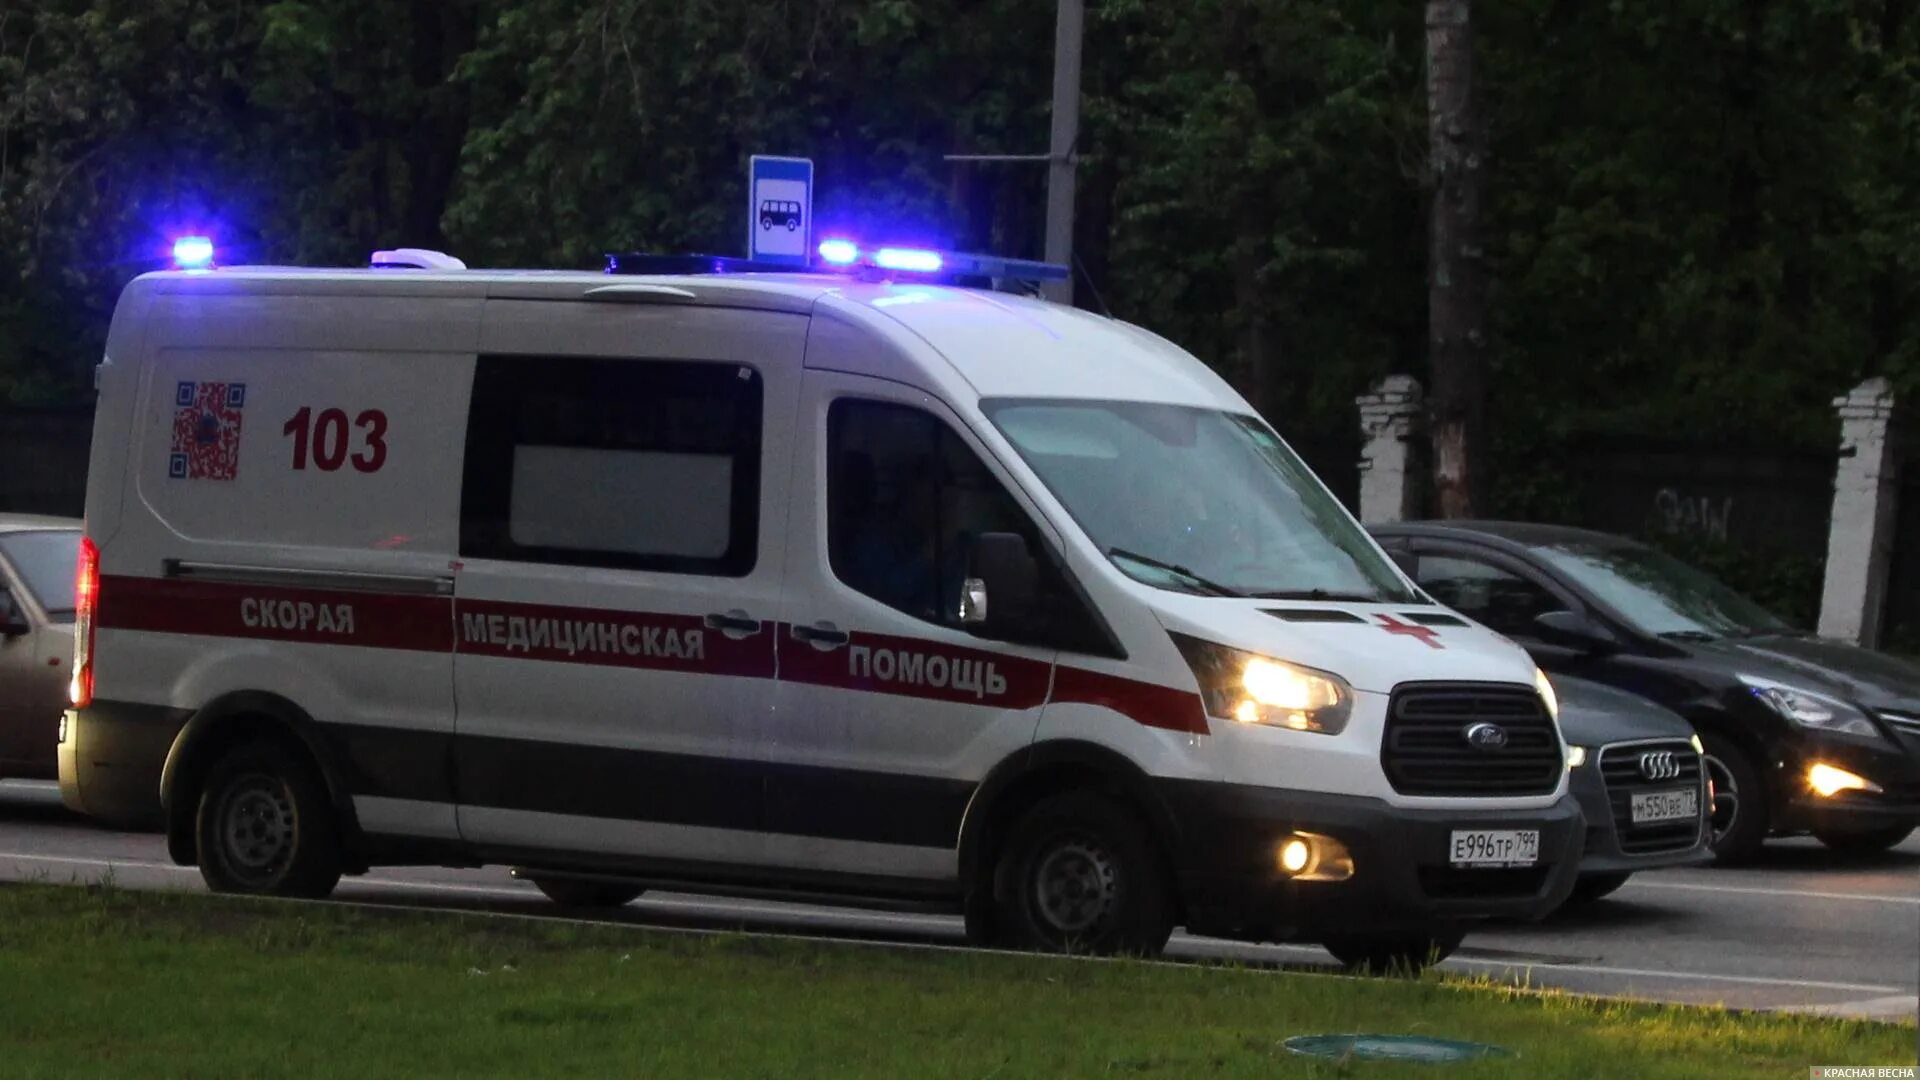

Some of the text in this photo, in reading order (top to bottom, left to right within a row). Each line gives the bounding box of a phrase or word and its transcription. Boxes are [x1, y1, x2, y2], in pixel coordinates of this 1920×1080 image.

[284, 407, 388, 473] 103
[241, 598, 1007, 698] СКОРАЯ МЕДИЦИНСКАЯ ПОМОЩЬ
[1456, 833, 1513, 858] Е996ТР
